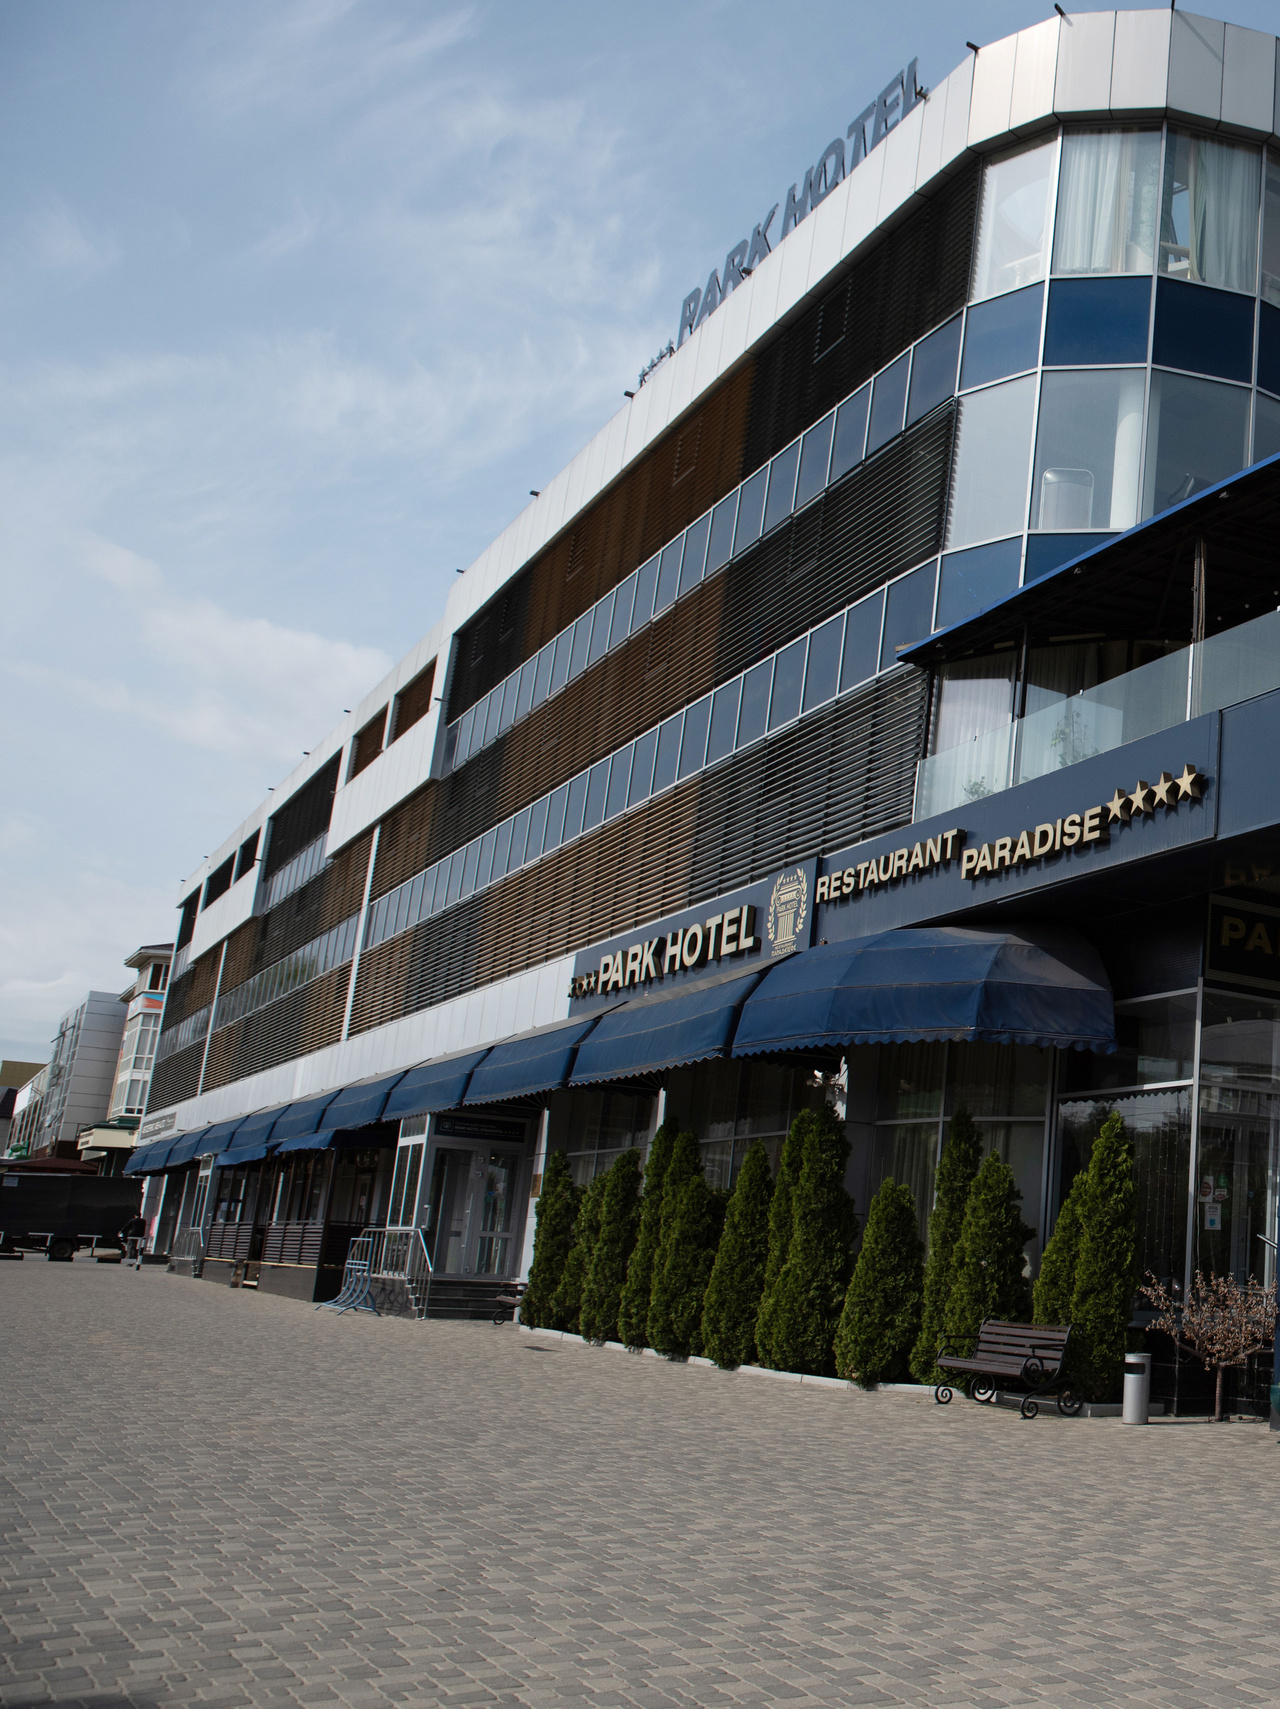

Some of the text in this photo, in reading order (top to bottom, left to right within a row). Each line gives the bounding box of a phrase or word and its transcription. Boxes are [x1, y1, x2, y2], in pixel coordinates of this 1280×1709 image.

[676, 56, 929, 348] PARK HOTEL
[815, 805, 1107, 904] RESTAURANT PARADISE
[597, 904, 758, 995] PARK HOTEL
[776, 900, 799, 912] PARK HOTEL
